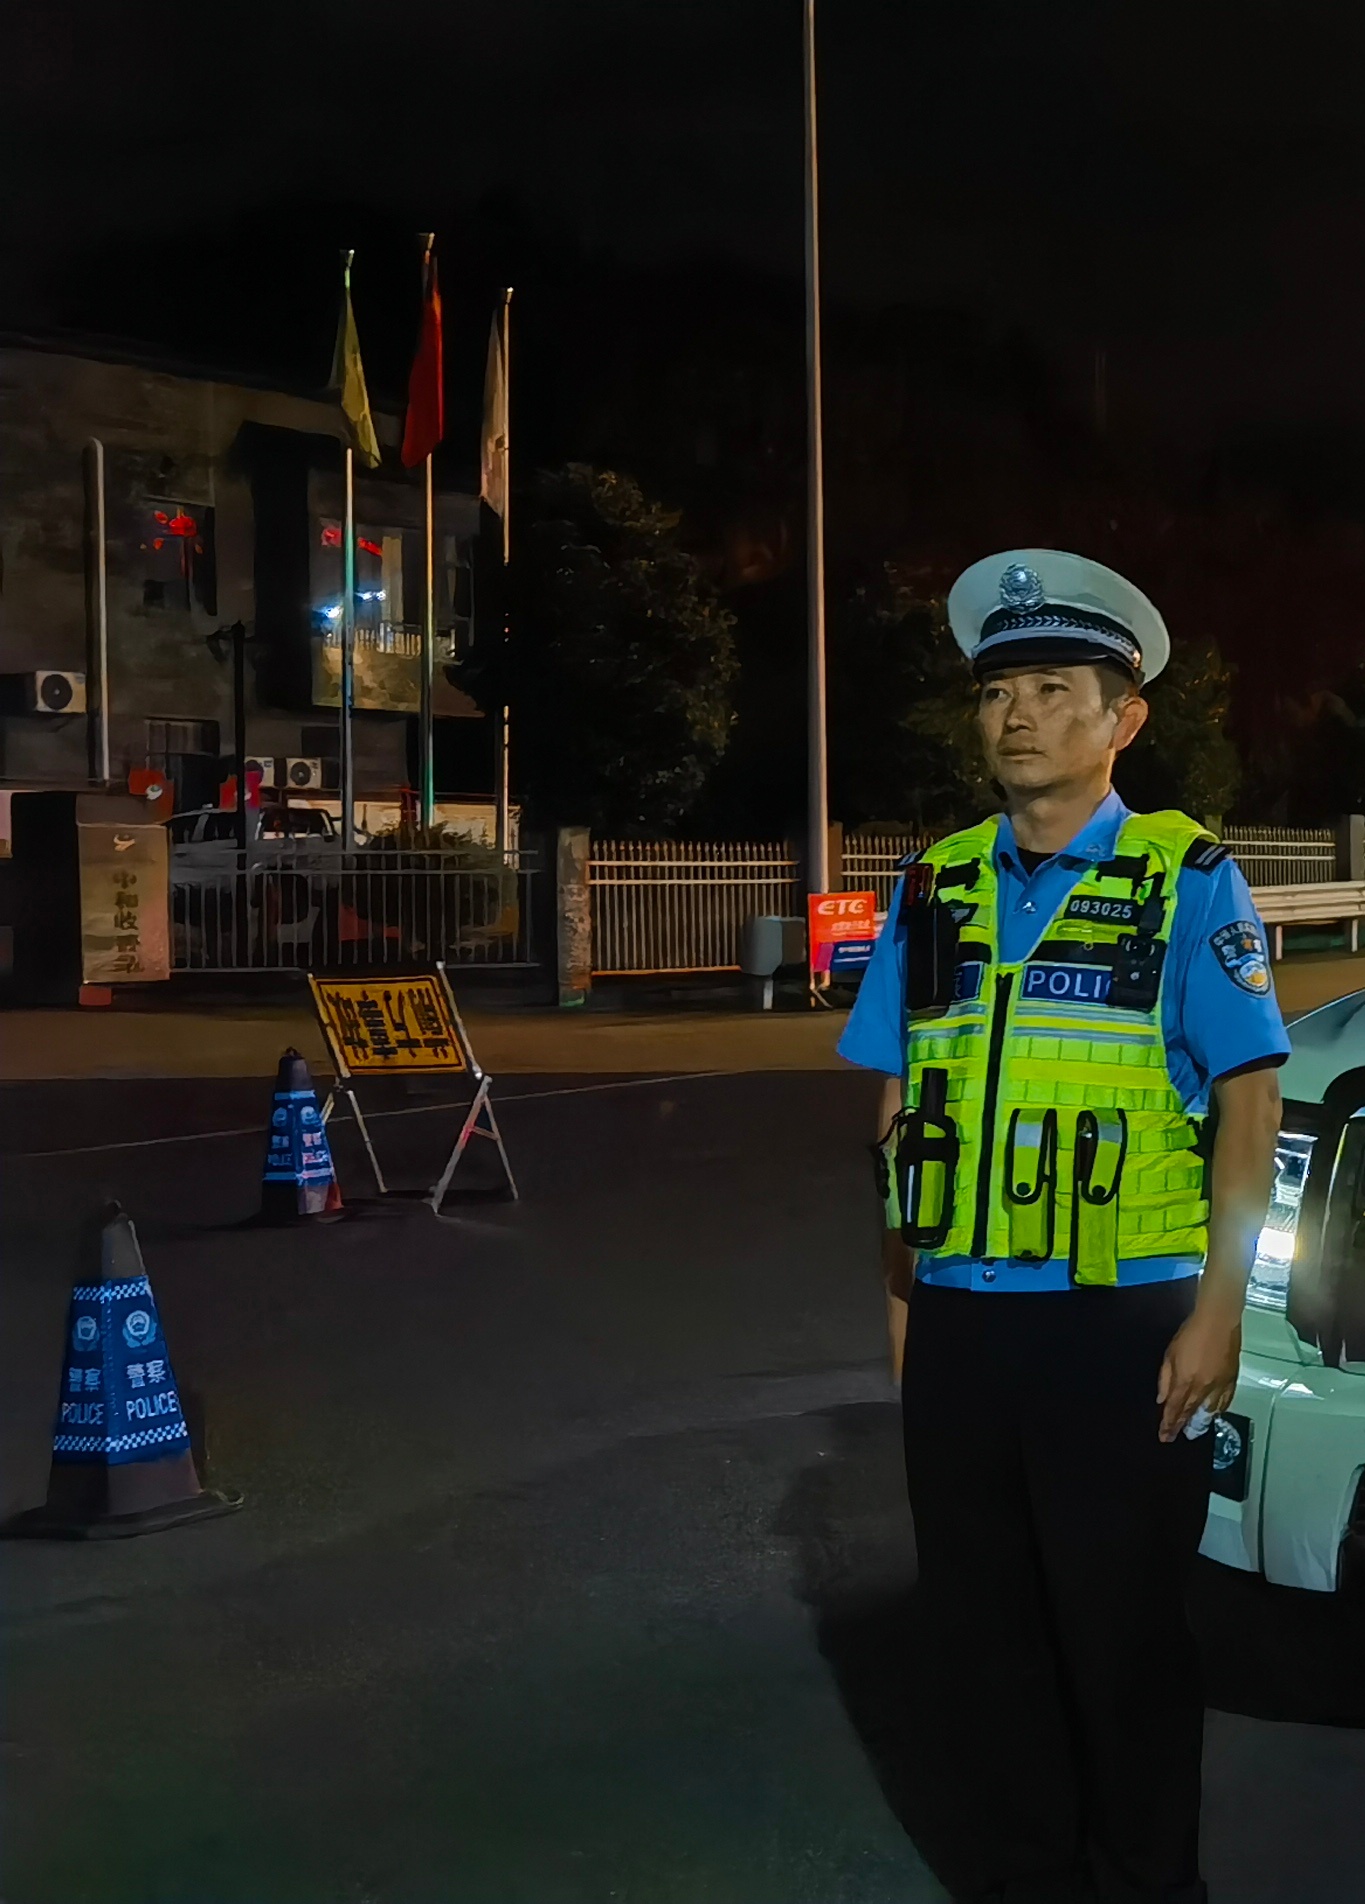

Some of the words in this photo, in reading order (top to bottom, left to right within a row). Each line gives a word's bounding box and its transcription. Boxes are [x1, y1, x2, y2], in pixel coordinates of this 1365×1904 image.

[817, 899, 868, 916] ETC
[1070, 899, 1133, 919] 093025
[1027, 969, 1112, 999] POLI
[126, 1359, 165, 1388] 警察
[62, 1402, 105, 1424] POLICE
[126, 1391, 177, 1421] POLICE
